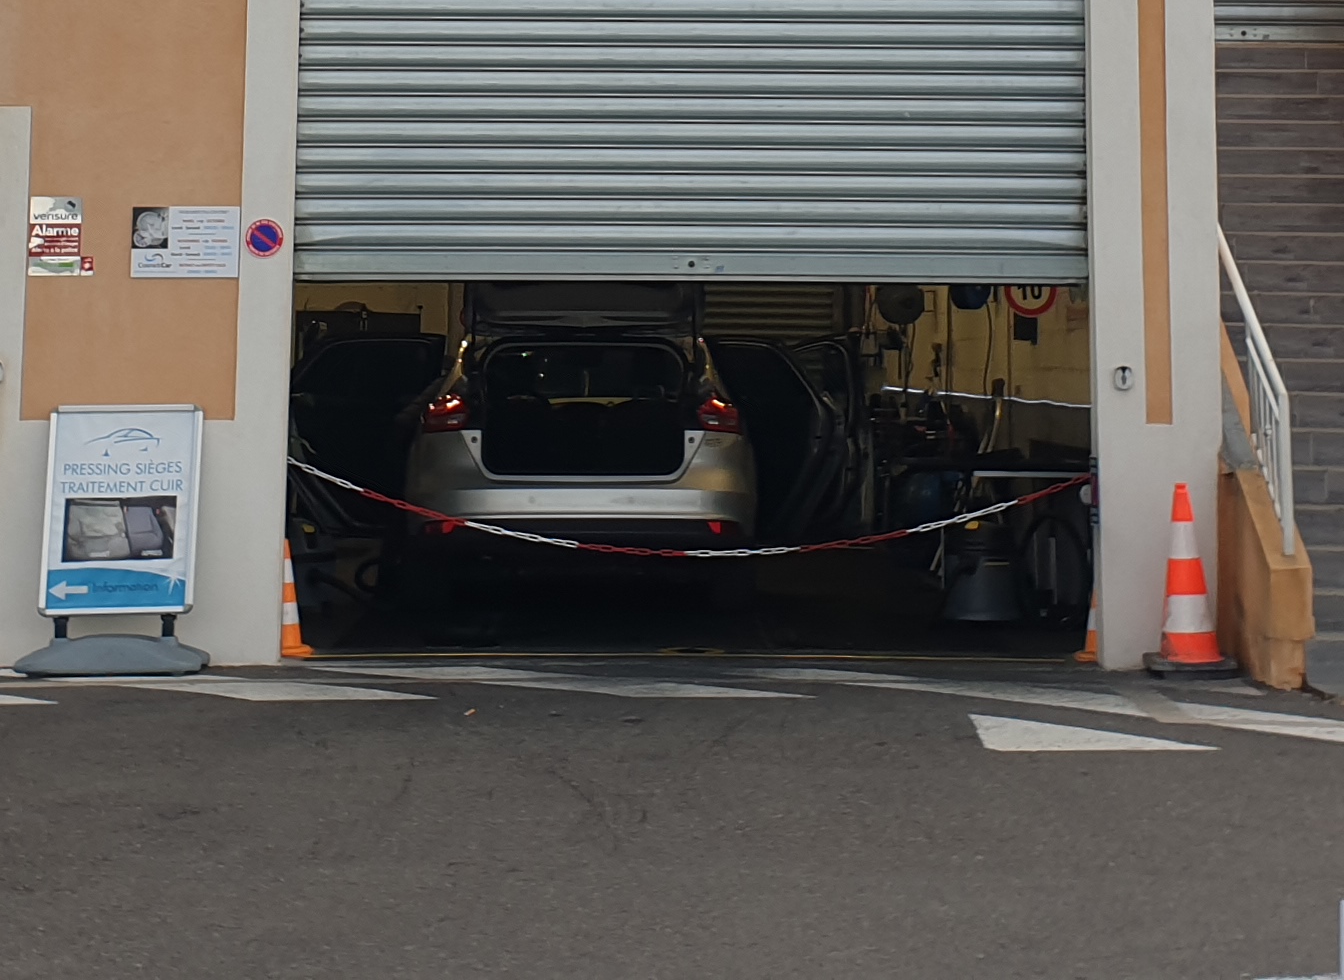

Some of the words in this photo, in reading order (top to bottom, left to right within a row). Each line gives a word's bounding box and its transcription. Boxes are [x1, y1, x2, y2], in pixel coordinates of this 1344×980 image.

[31, 224, 79, 236] Alarme
[63, 463, 131, 476] PRESSING
[135, 459, 182, 475] SIÈGES
[60, 480, 146, 494] TRAITEMENT
[149, 479, 183, 491] CUIR
